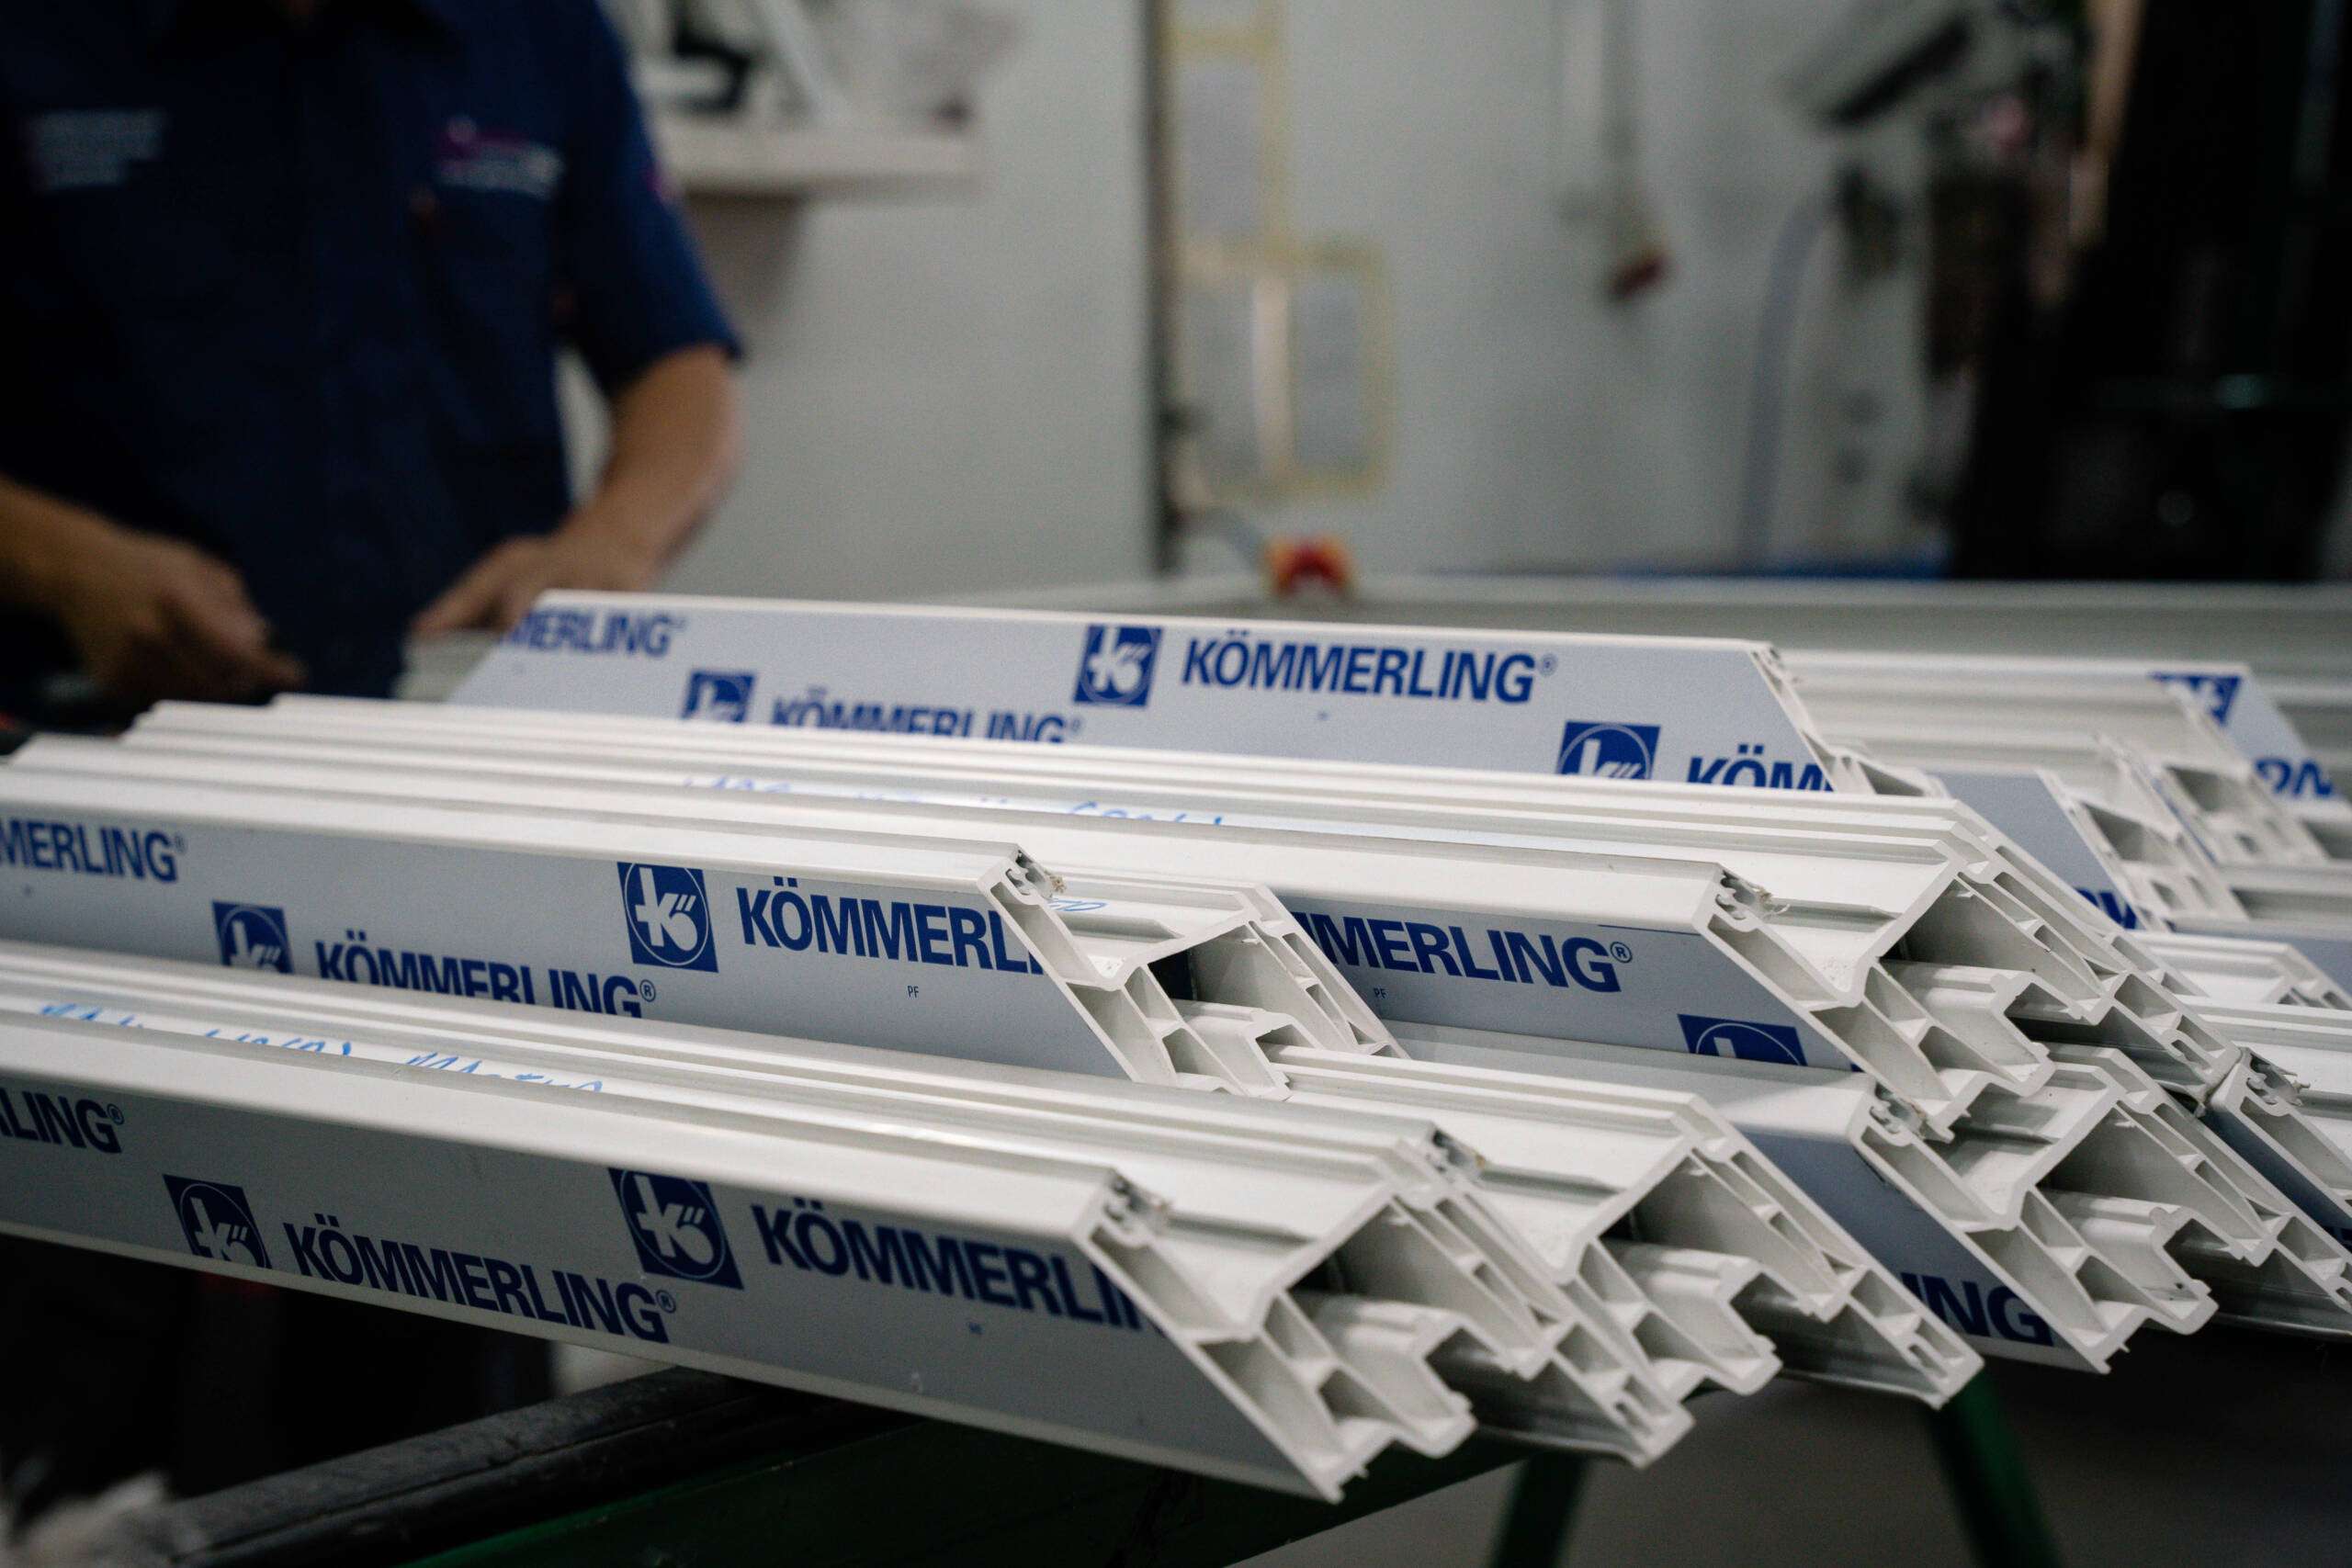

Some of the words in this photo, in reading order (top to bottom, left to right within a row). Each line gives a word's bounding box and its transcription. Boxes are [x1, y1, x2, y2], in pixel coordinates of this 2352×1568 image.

[1685, 744, 1834, 792] KÖM
[736, 875, 1044, 976] KÖMMERL
[1289, 910, 1633, 993] MERLING®
[907, 985, 920, 998] PF
[0, 1088, 125, 1154] LING®
